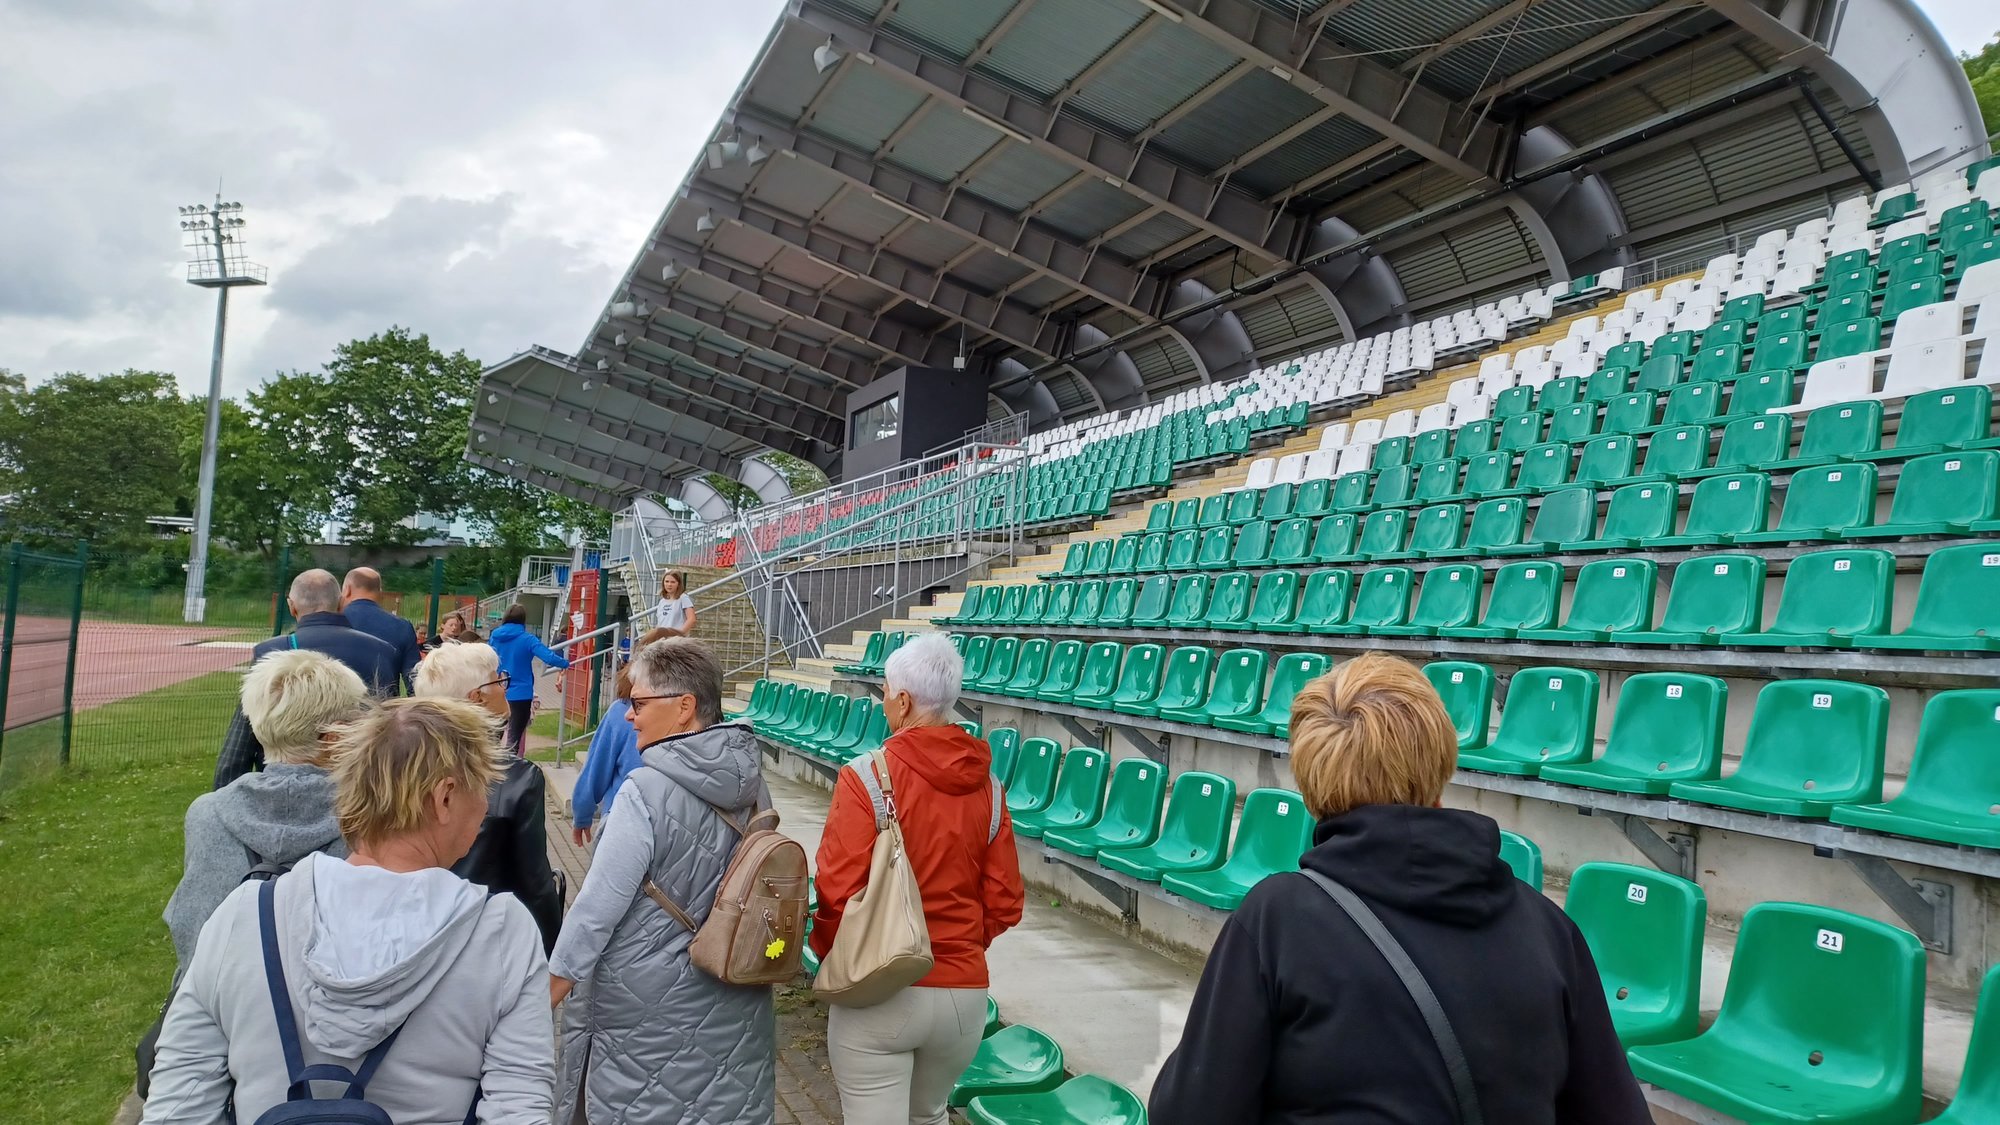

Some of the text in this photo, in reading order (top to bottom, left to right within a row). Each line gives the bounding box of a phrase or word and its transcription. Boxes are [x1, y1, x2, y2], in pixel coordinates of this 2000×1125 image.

[1987, 556, 1999, 564] 19
[1670, 687, 1680, 696] 18
[1817, 697, 1829, 705] 19
[1631, 887, 1644, 899] 20
[1822, 933, 1838, 948] 21
